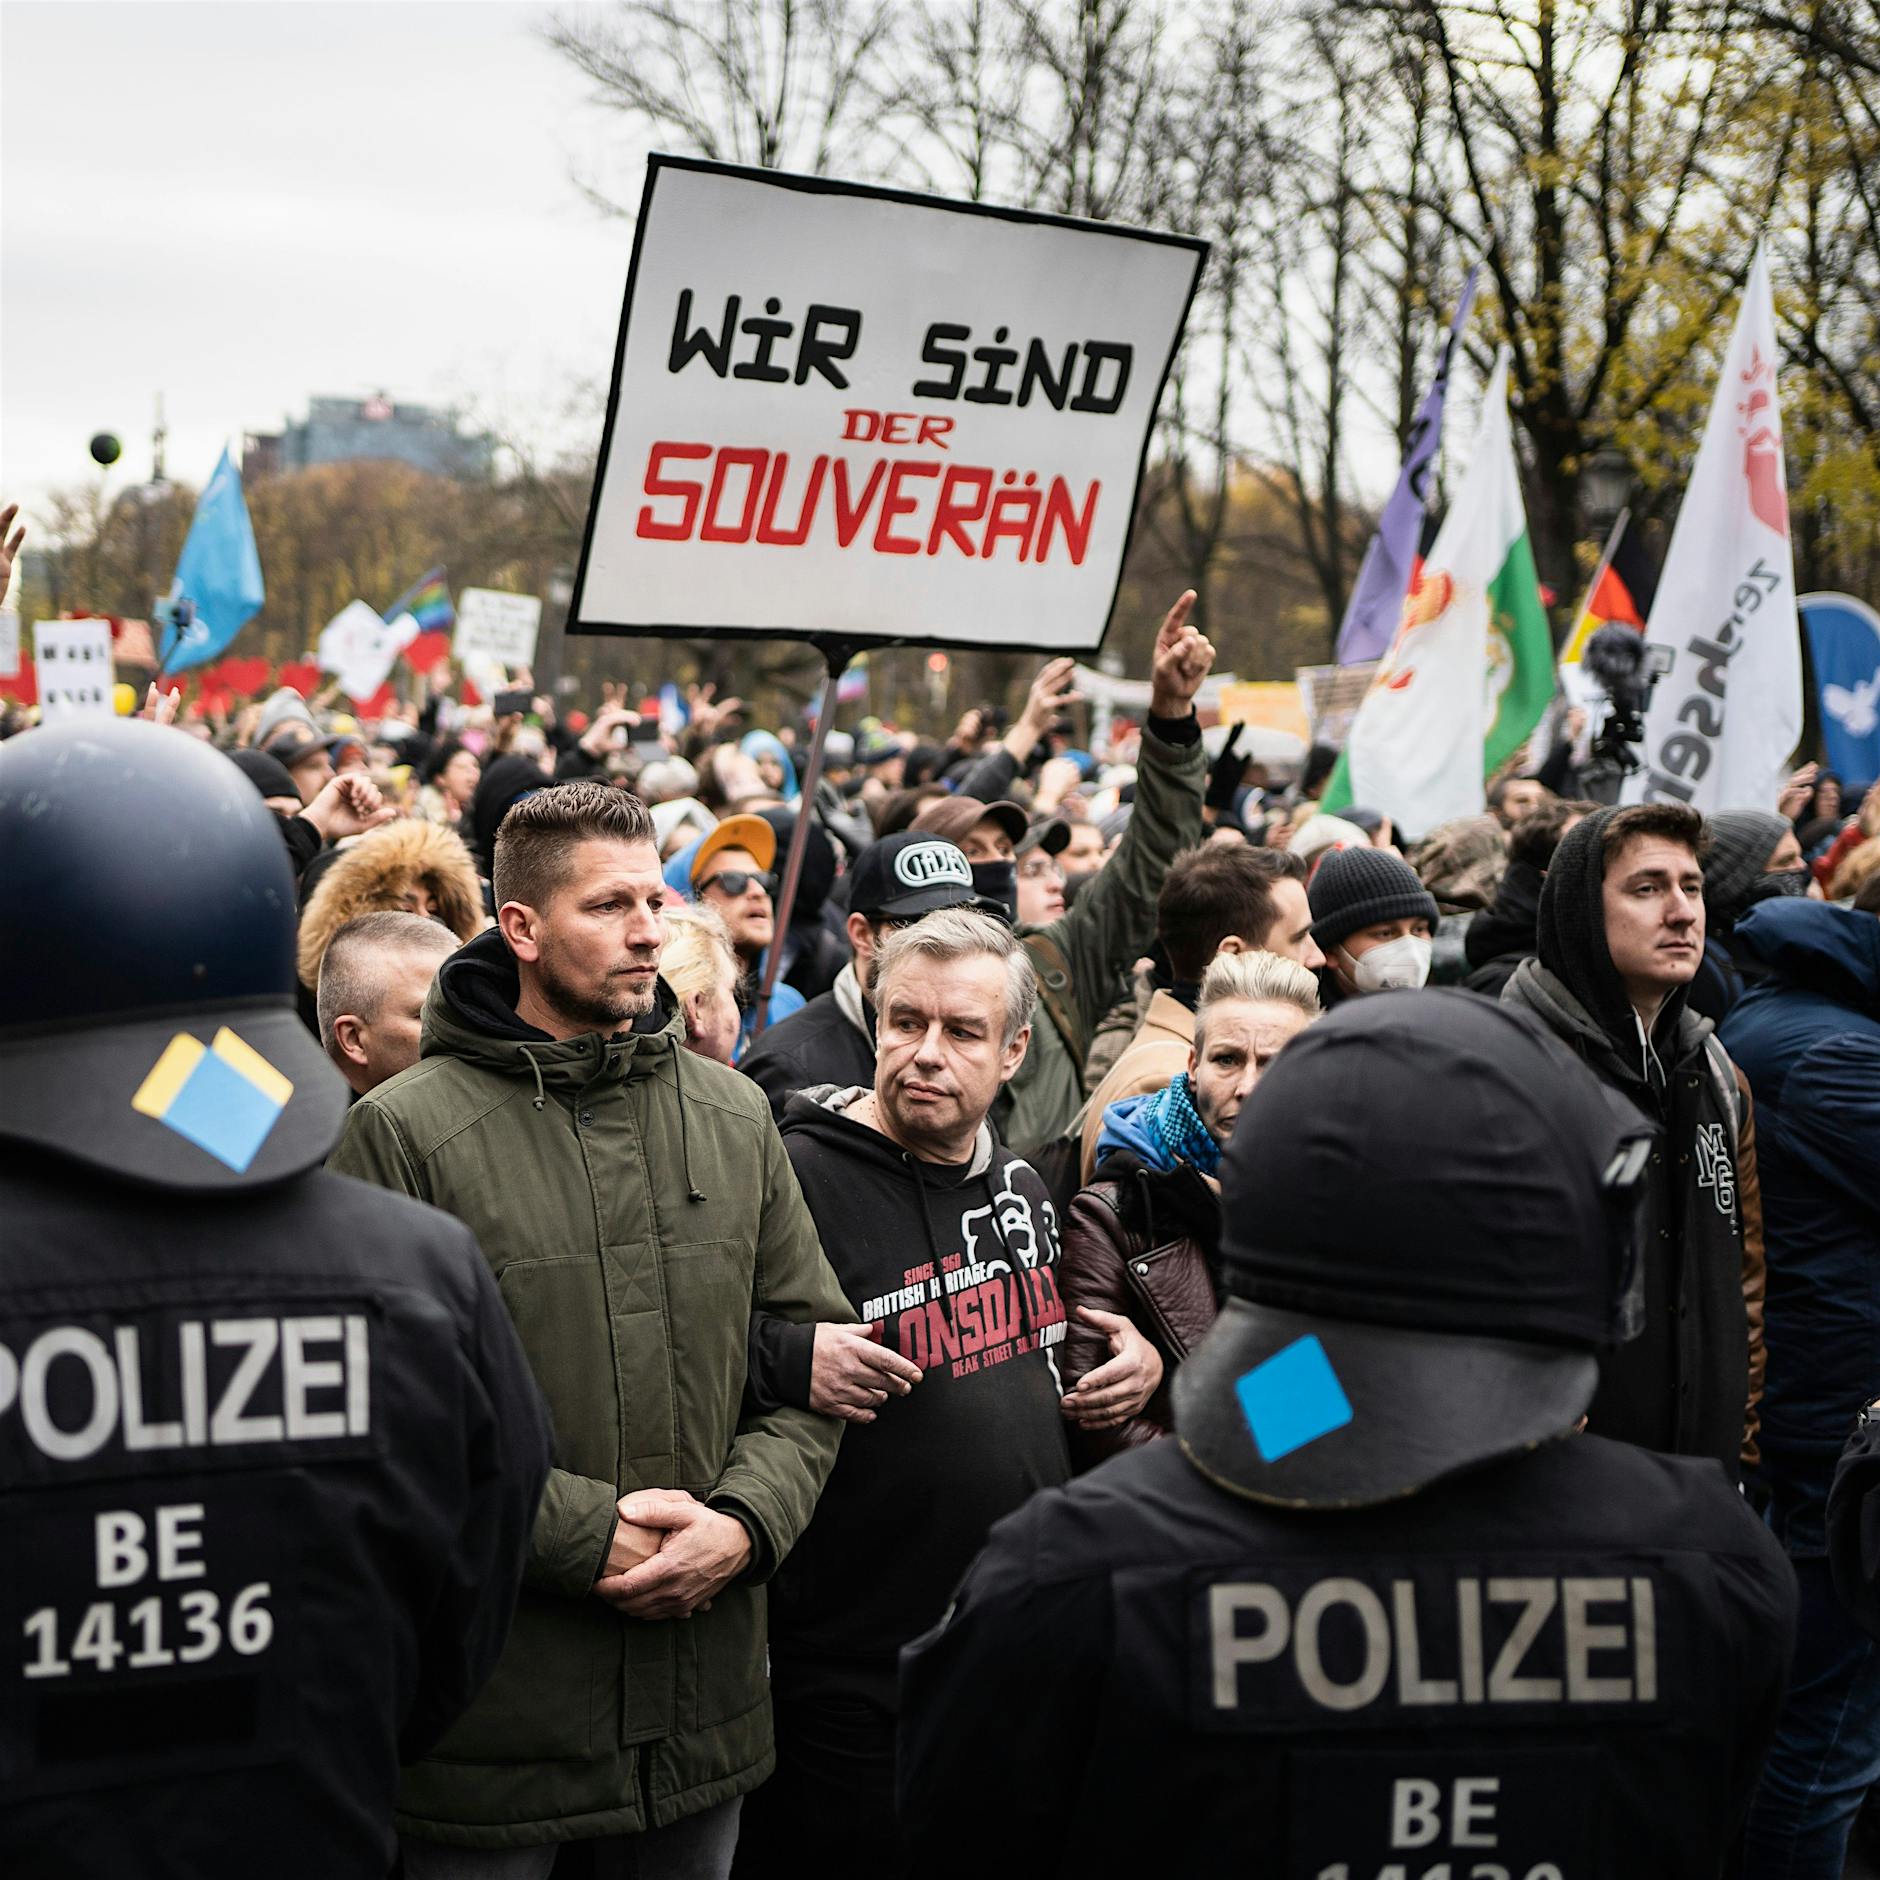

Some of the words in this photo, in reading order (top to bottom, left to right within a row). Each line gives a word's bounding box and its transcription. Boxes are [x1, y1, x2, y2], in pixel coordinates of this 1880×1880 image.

[840, 408, 956, 450] DER
[635, 441, 1102, 567] SOUVERÄN
[862, 1282, 925, 1323] BRITISH
[929, 1260, 988, 1300] HRITAGE
[903, 1260, 936, 1287] SINCE
[939, 1252, 962, 1274] 960
[951, 1354, 980, 1379] BEAK
[982, 1341, 1014, 1368] STREET
[95, 1503, 206, 1588] BE
[23, 1582, 274, 1679] 14136
[1209, 1577, 1657, 1710] POLIZEI
[1390, 1778, 1499, 1848] BE
